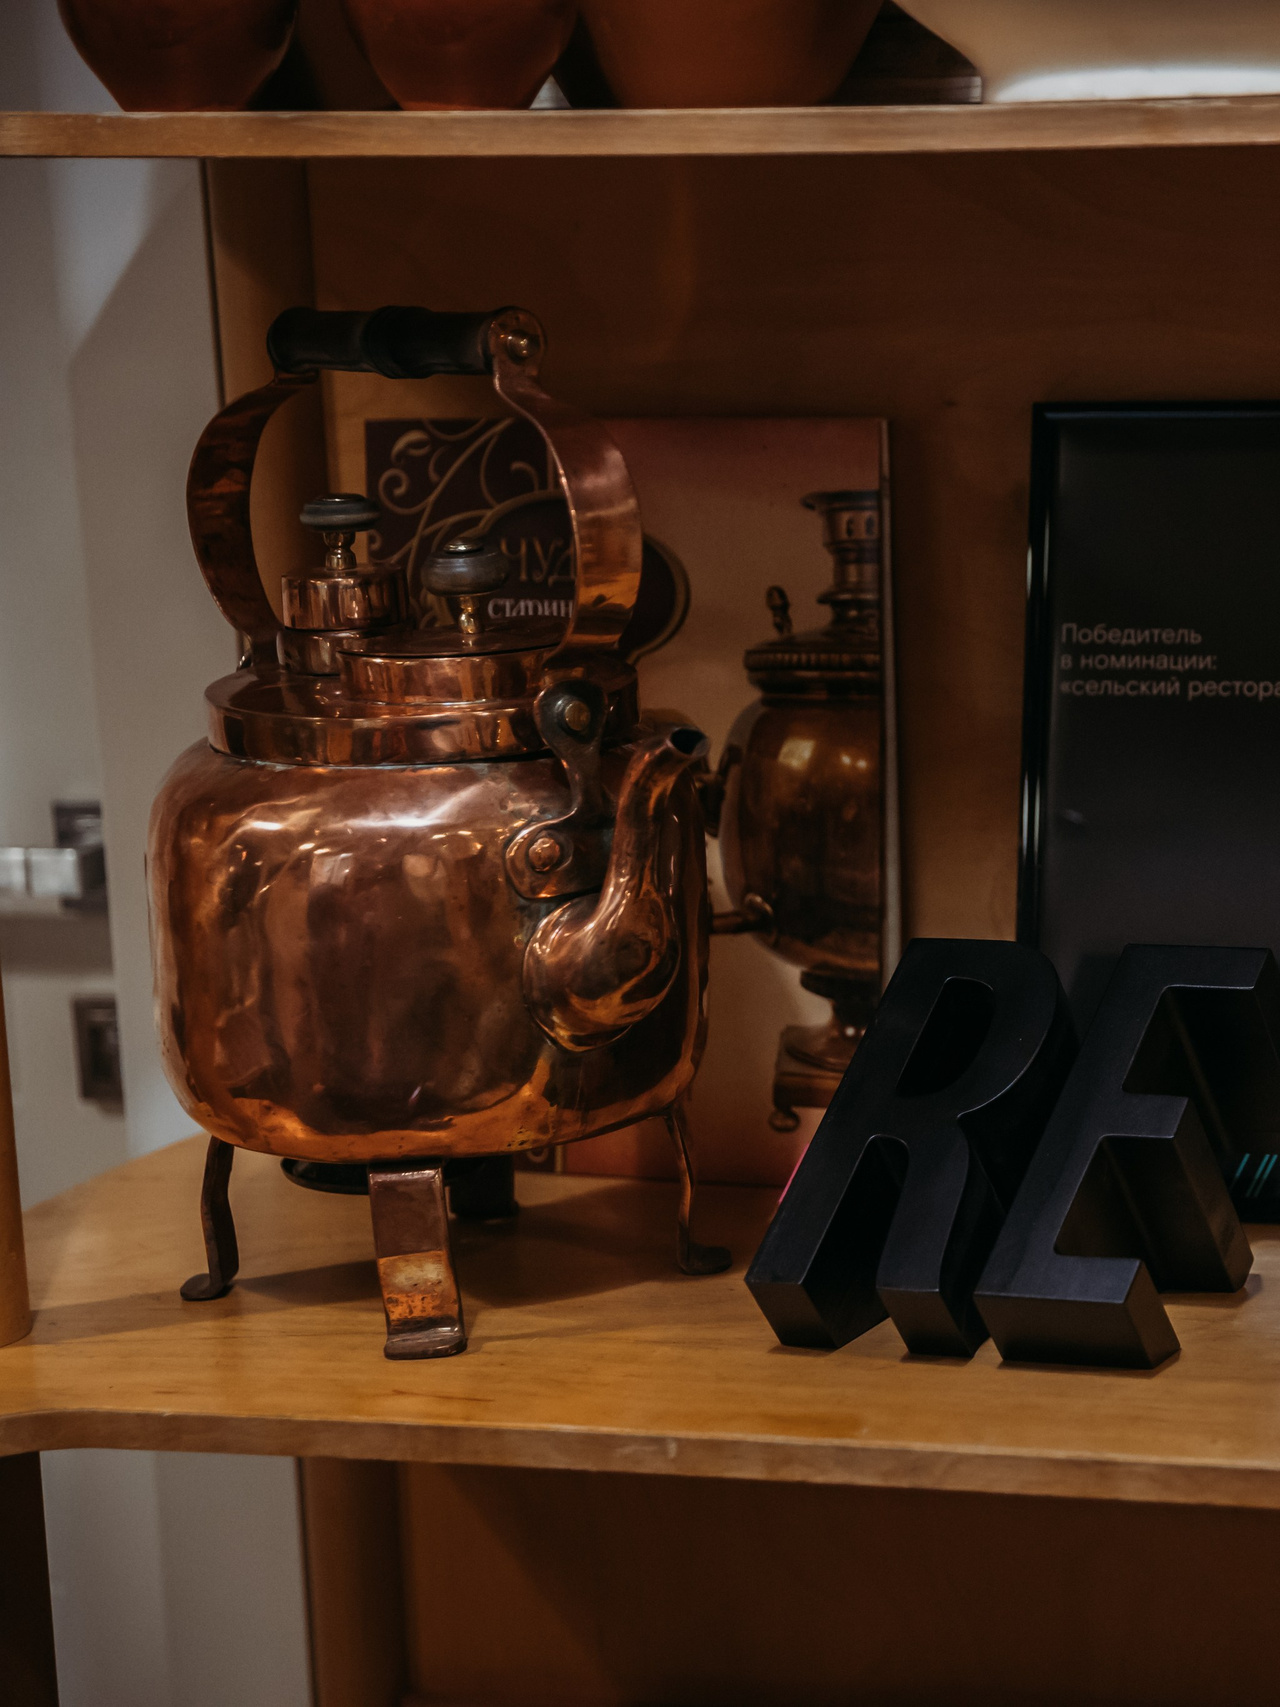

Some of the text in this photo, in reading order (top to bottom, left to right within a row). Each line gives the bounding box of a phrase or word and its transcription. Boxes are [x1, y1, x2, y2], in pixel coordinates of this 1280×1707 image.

[500, 536, 576, 588] ЧУД
[487, 598, 574, 619] СТАРИН
[1060, 622, 1203, 646] Победитель
[1060, 654, 1218, 672] в номинации:
[1060, 677, 1181, 696] «сельский
